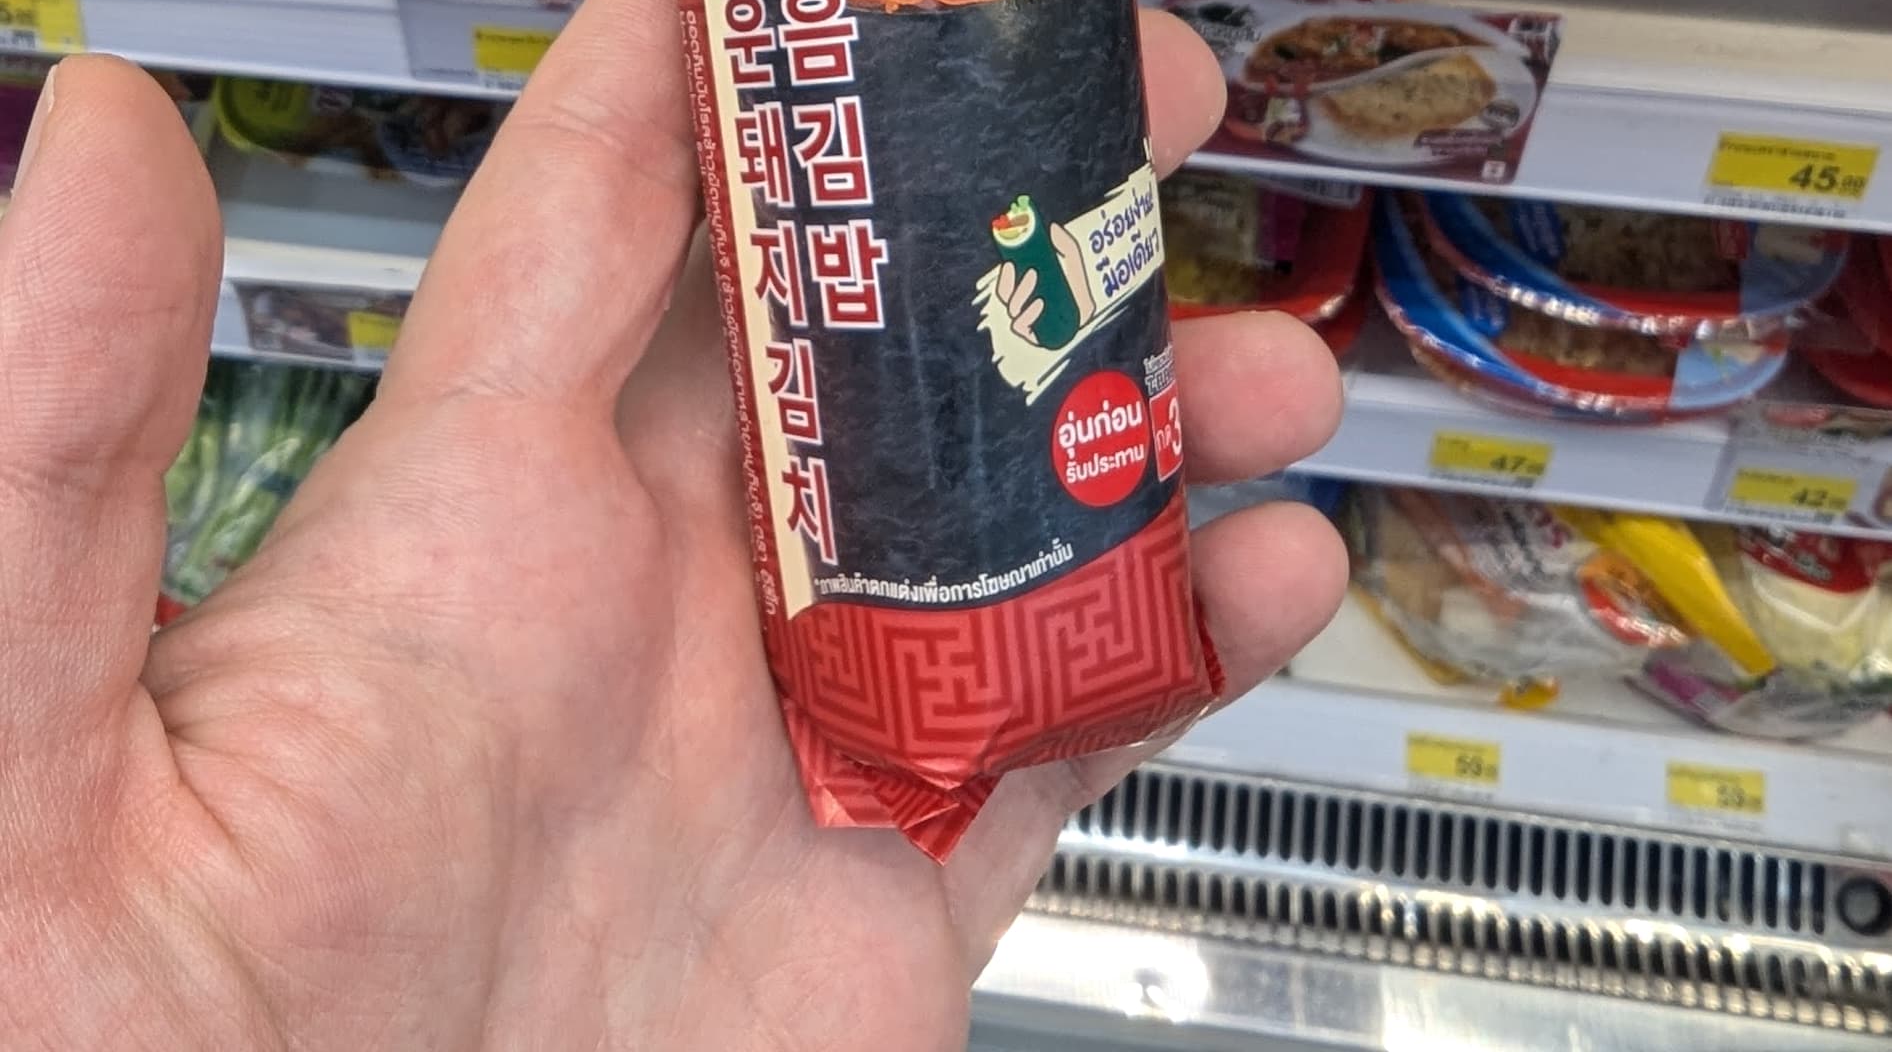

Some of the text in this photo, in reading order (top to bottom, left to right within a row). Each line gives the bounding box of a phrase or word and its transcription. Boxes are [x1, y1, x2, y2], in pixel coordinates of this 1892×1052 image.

[1096, 227, 1160, 298] มือเดียว
[1058, 399, 1143, 460] อุ่นก่อน
[1168, 397, 1183, 456] 3
[1066, 443, 1145, 484] รับประทาน
